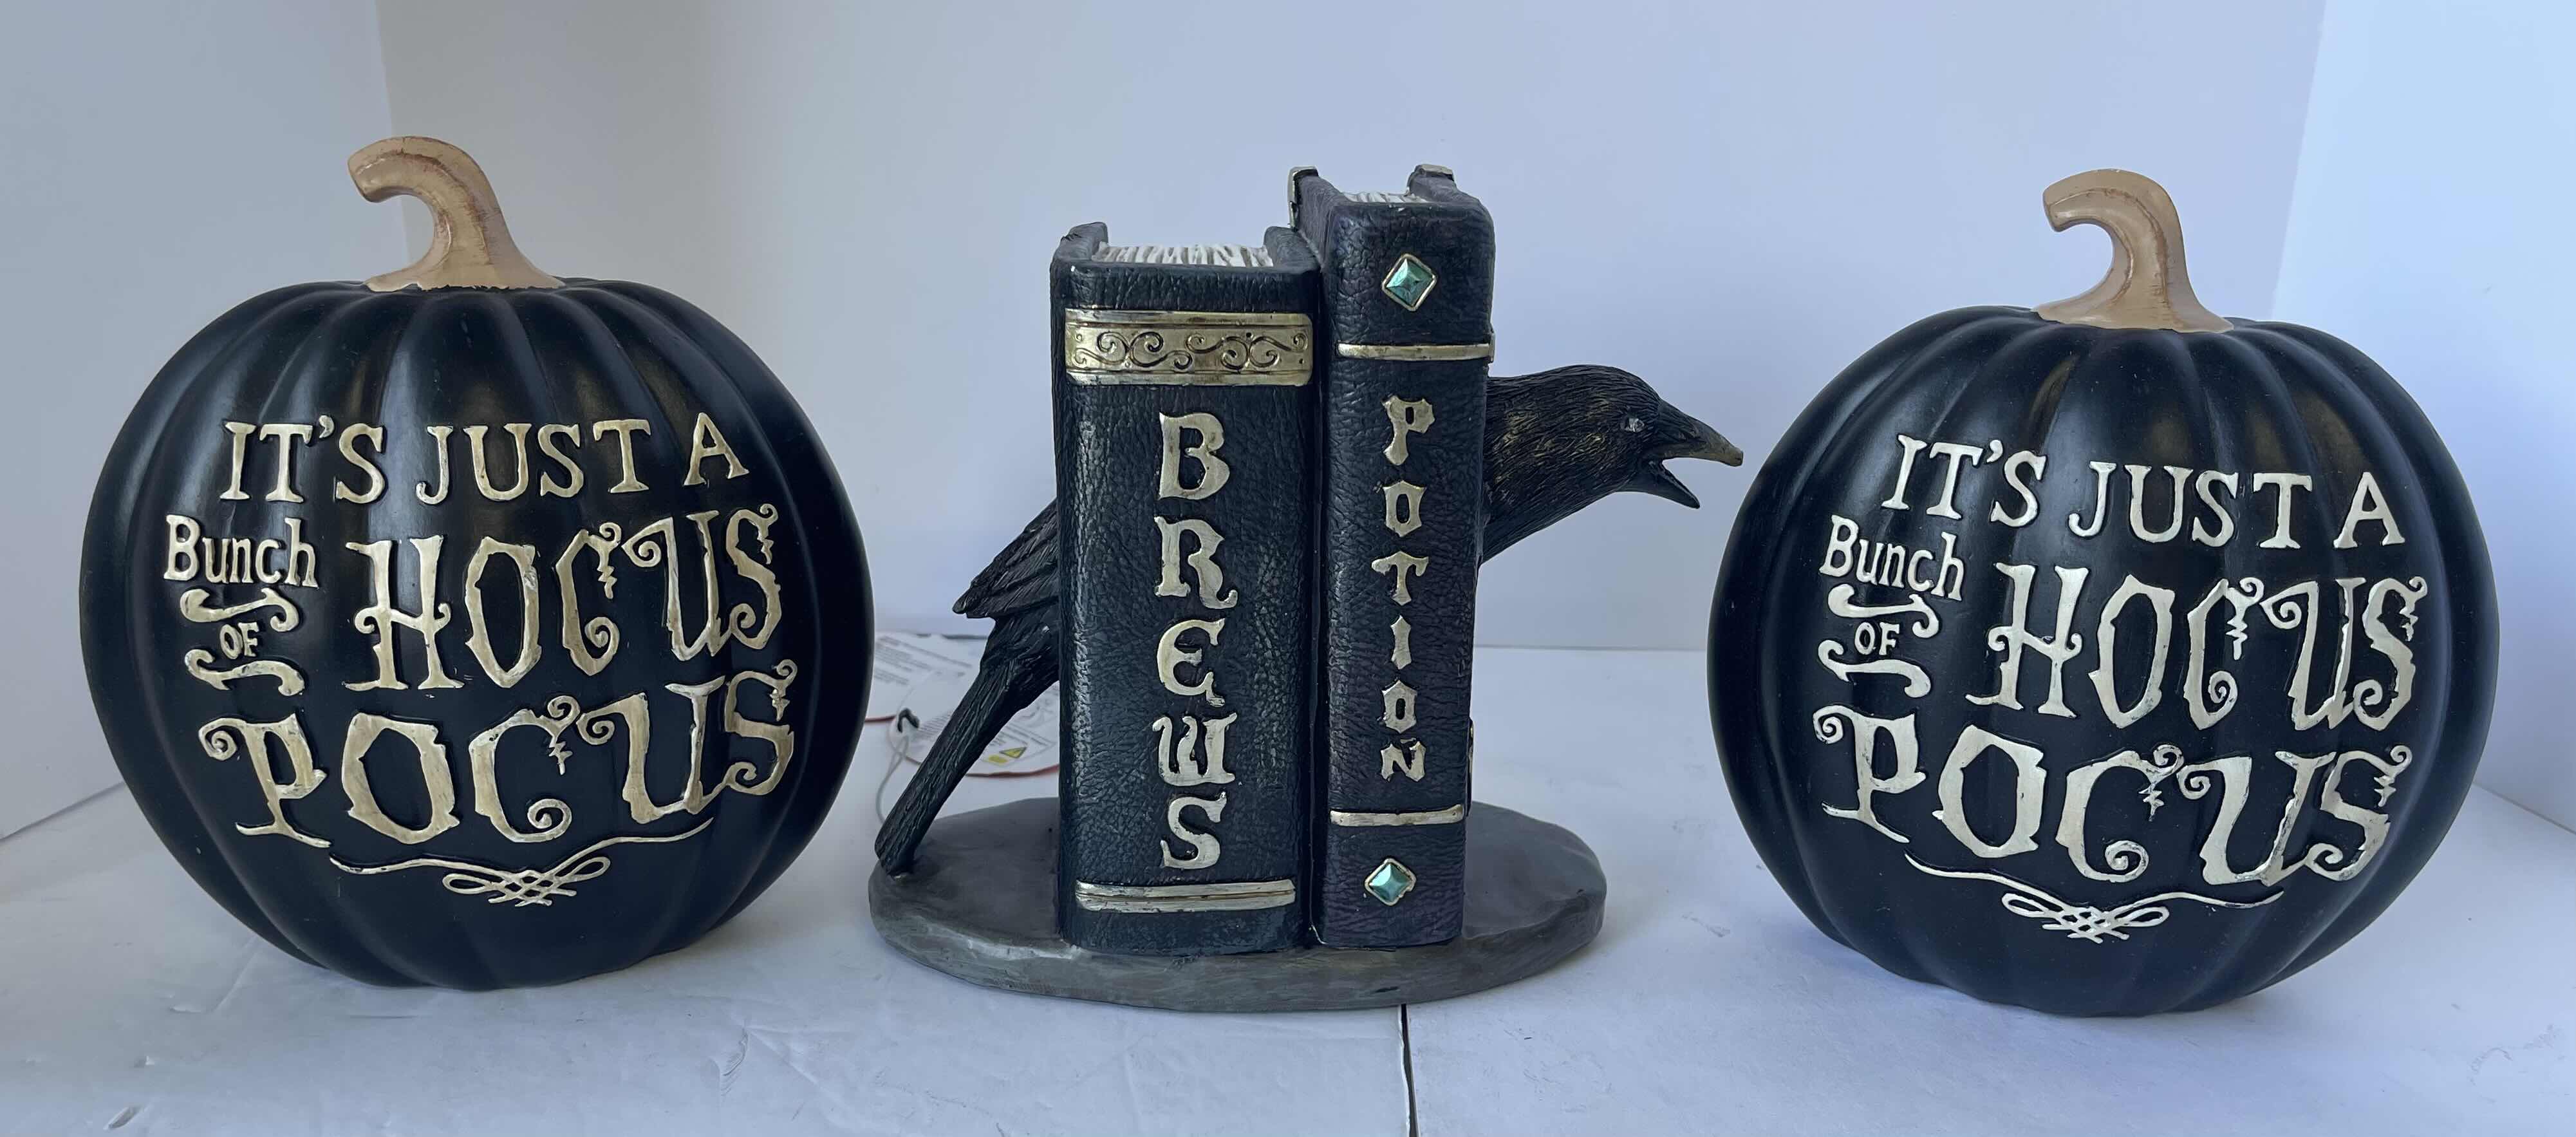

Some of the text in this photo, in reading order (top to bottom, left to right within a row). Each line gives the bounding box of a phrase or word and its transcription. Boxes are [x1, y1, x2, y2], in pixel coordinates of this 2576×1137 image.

[221, 412, 749, 504] IT'S JUST A
[1882, 435, 2404, 549] IT'S JUST A
[164, 514, 318, 587] Bunch
[342, 503, 781, 690] HOCUS
[1372, 395, 1435, 782] POTION
[1820, 515, 1965, 601] Bunch
[221, 622, 261, 659] OF
[1153, 412, 1238, 870] BREWS
[1855, 621, 1900, 655] OF
[1966, 563, 2427, 730] HOCUS
[198, 659, 794, 847] POCUS
[1813, 704, 2412, 886] POCUS
